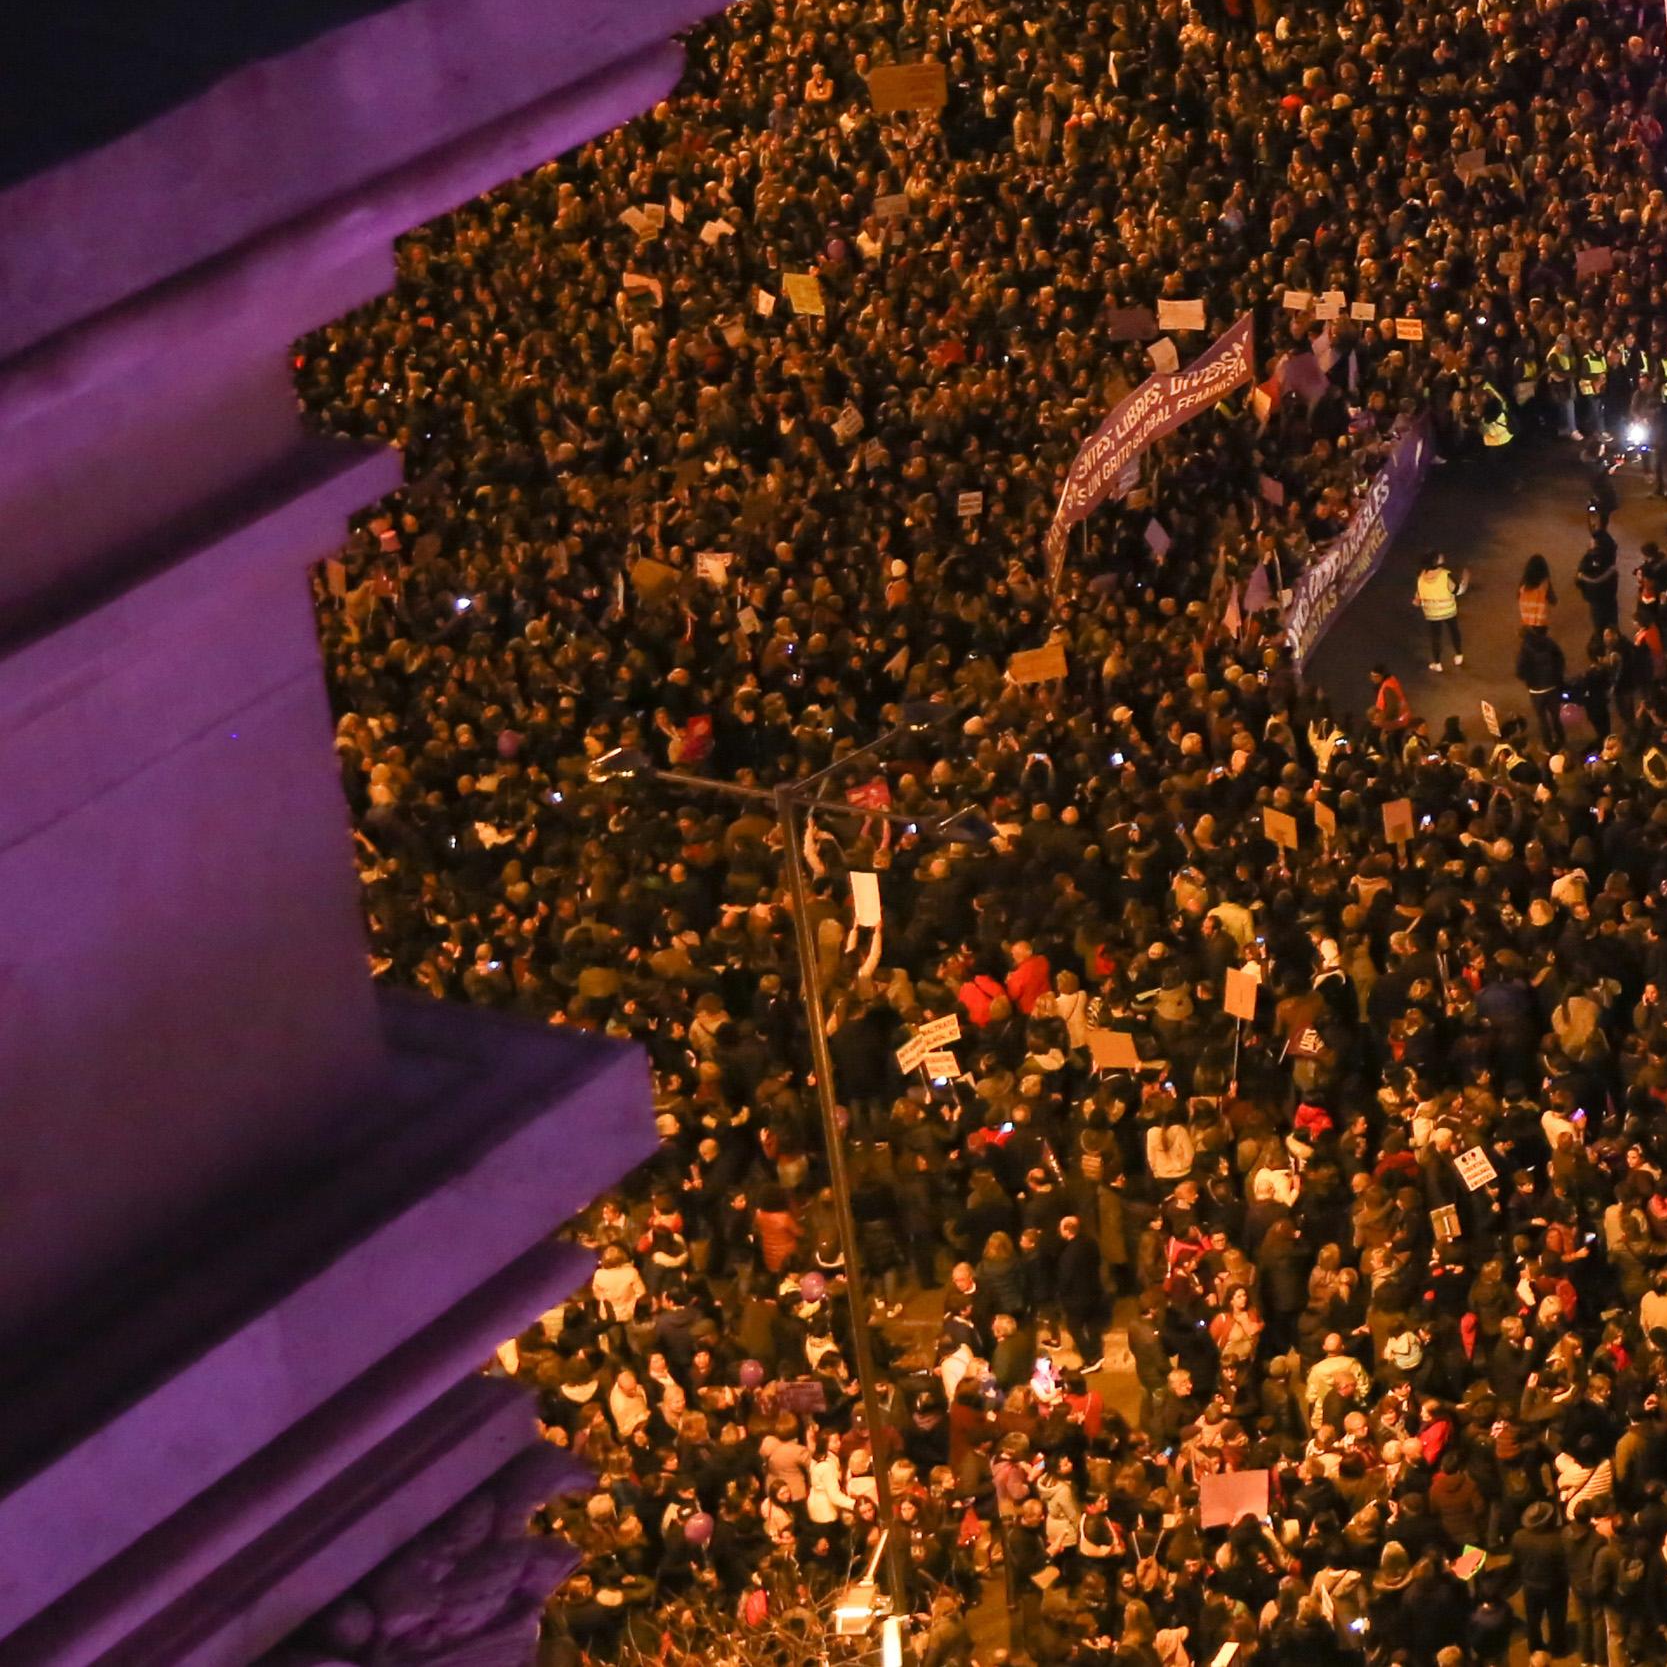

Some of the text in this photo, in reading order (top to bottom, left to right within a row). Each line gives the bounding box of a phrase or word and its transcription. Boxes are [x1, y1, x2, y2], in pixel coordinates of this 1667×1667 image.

[1102, 441, 1132, 481] GRITO
[1132, 405, 1171, 450] GLOBAL
[1117, 382, 1164, 439] LIBRES,
